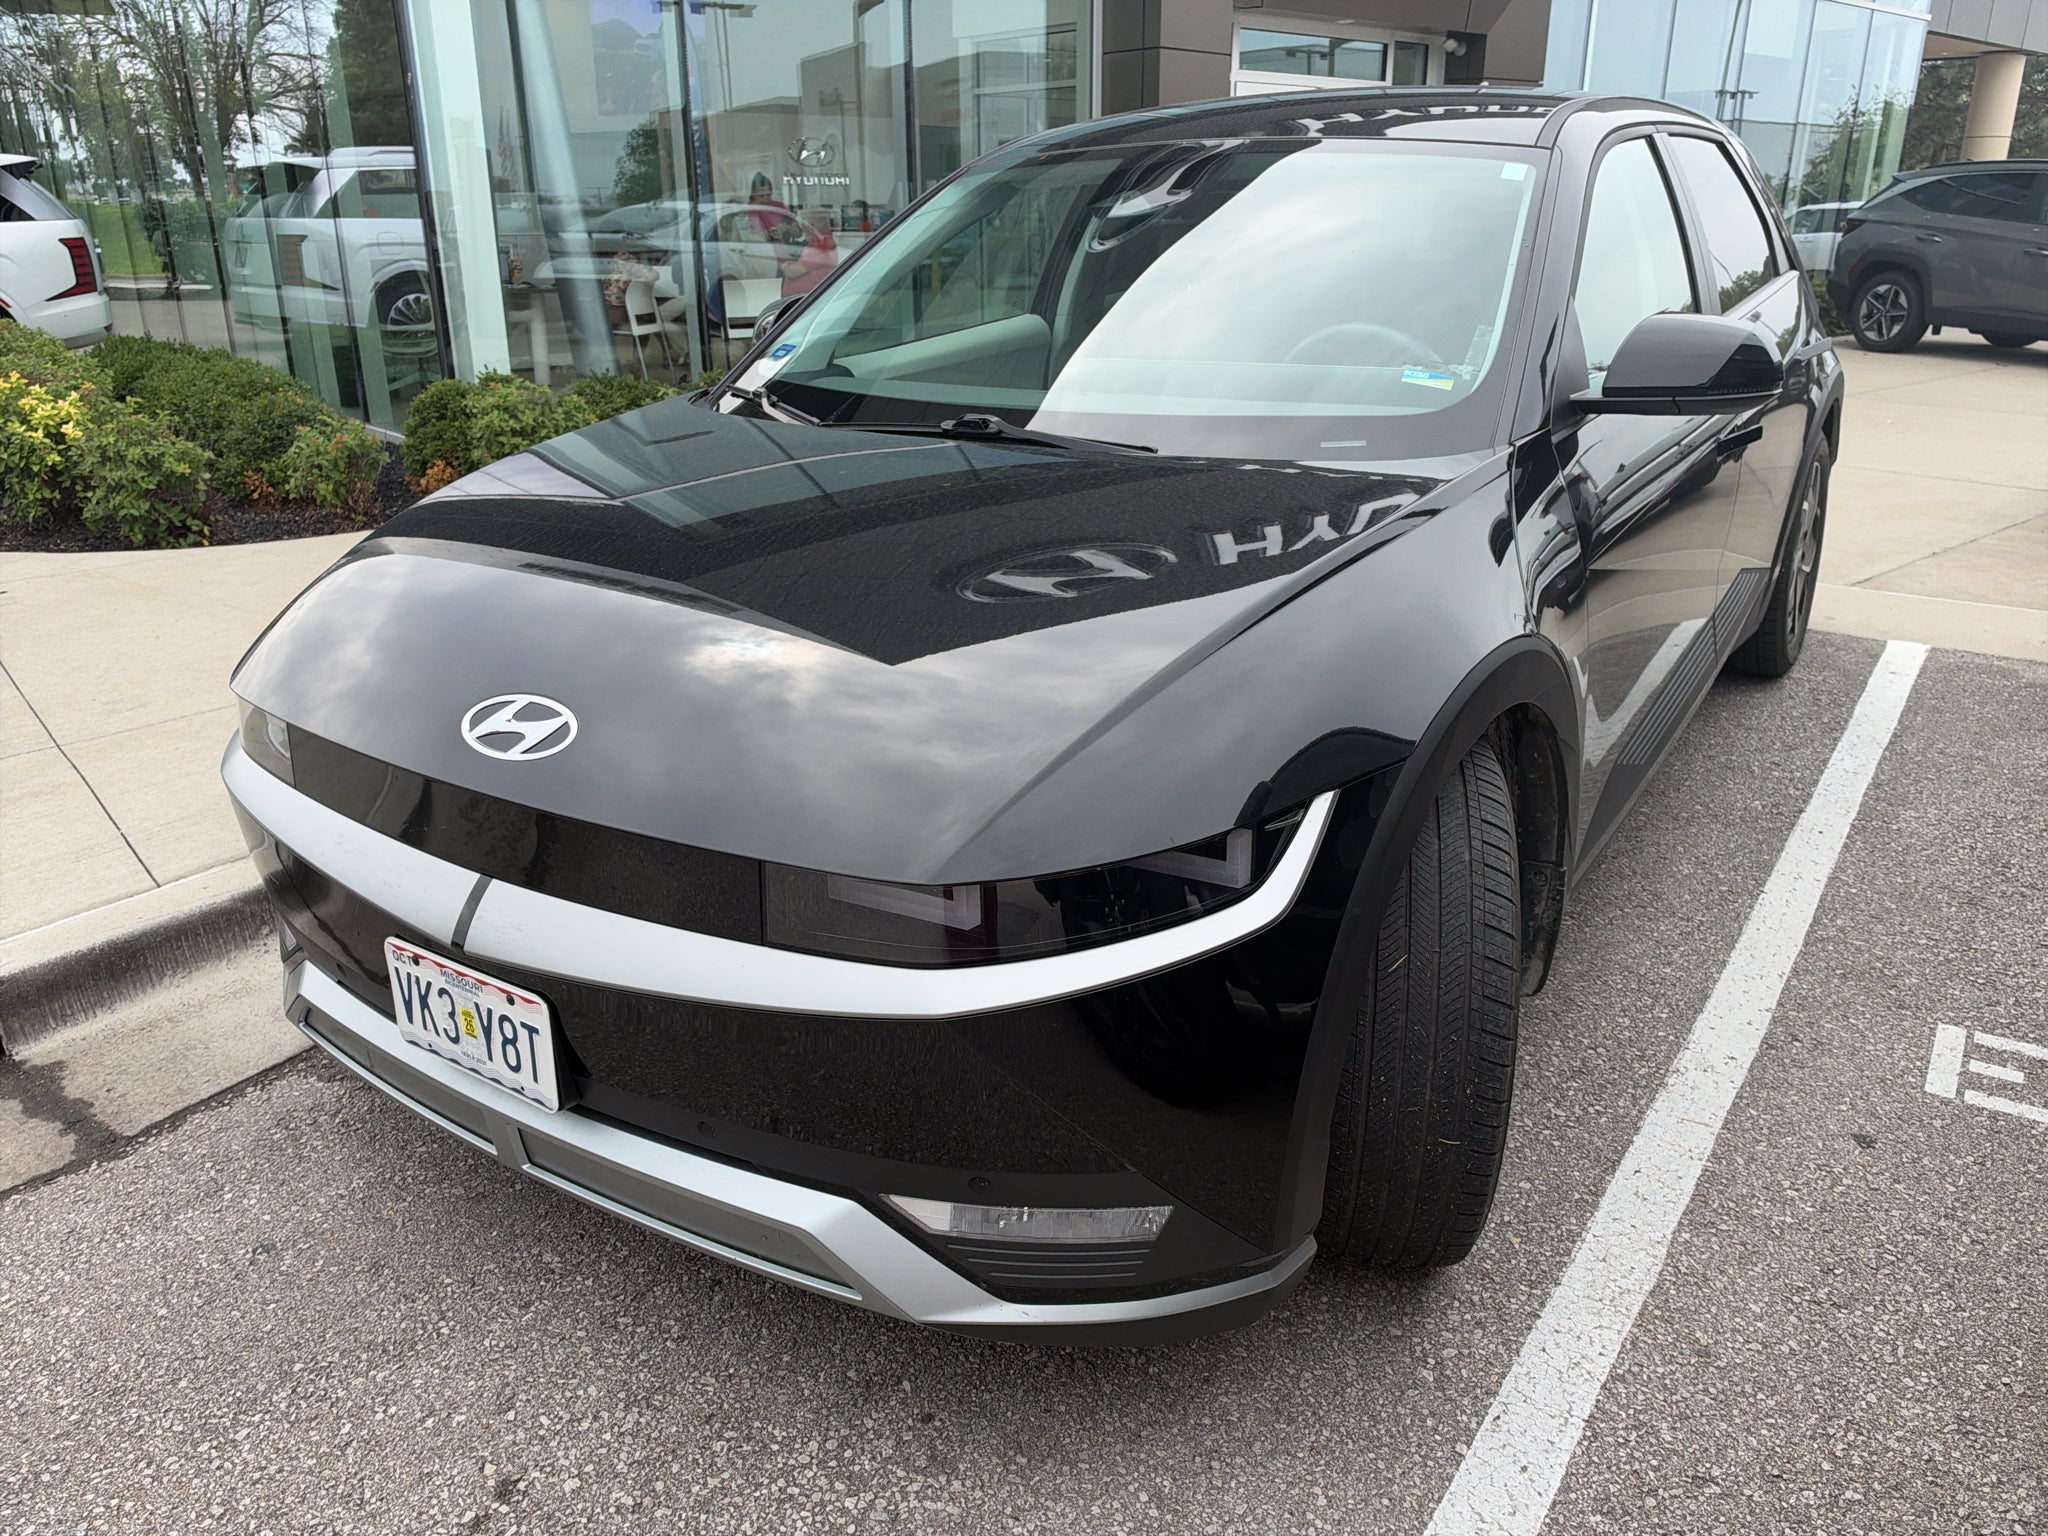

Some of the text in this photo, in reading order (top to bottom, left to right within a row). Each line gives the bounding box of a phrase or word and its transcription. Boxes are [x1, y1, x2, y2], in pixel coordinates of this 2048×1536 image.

[392, 949, 412, 967] OCT
[440, 968, 483, 993] MISSOURI
[394, 966, 540, 1084] VK3 Y8T
[464, 1017, 475, 1034] 26
